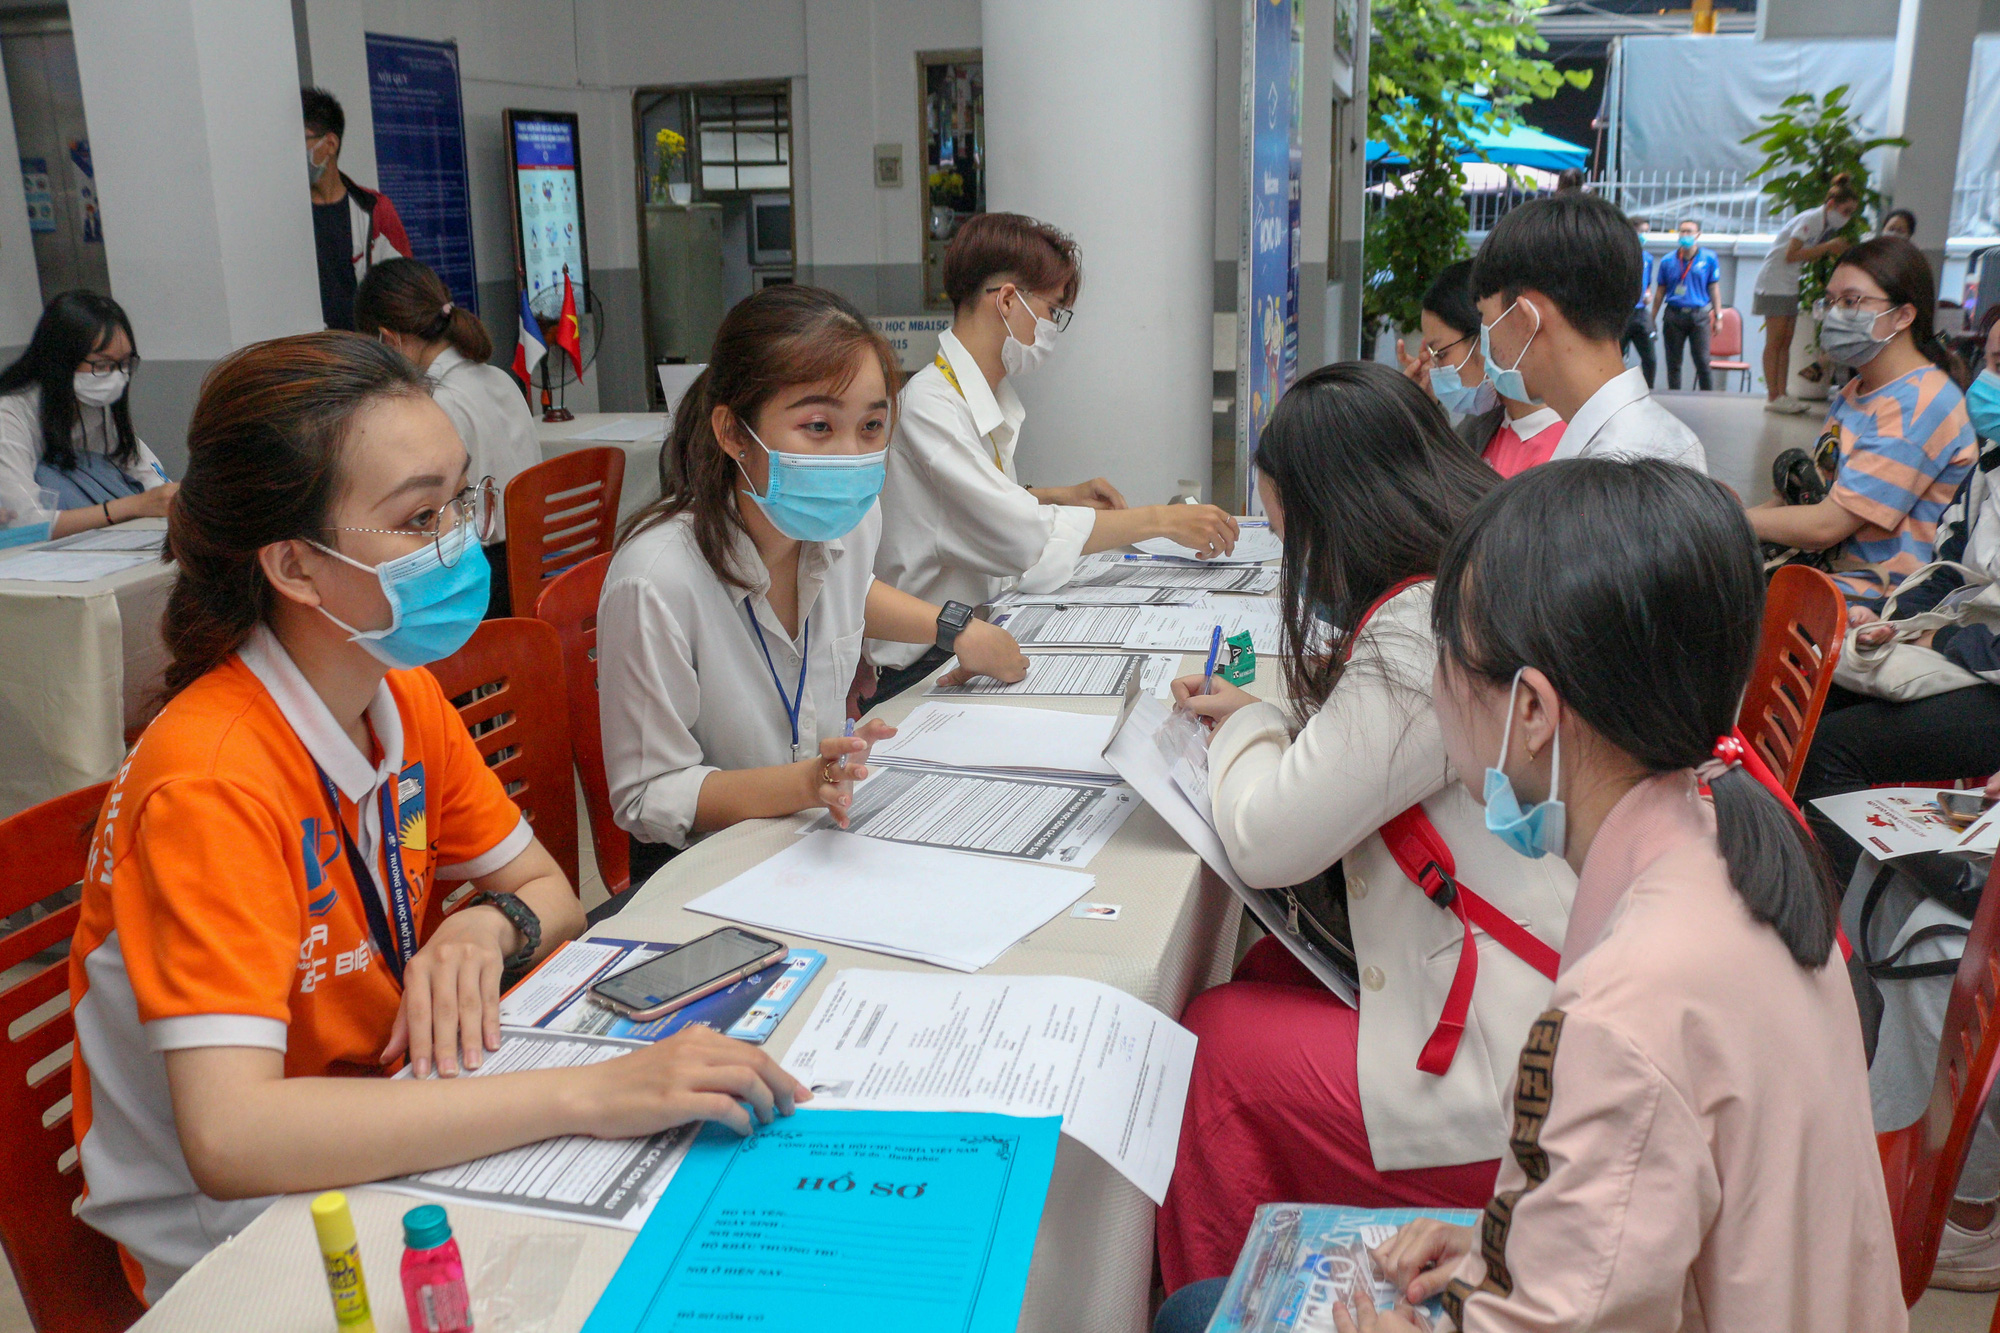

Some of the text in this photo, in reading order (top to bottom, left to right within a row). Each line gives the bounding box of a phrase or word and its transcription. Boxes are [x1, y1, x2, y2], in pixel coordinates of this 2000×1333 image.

[885, 321, 907, 333] HỌC
[908, 320, 949, 331] MBA15C
[892, 339, 908, 350] 015
[390, 852, 402, 888] TRƯỜNG
[394, 888, 404, 904] ĐẠI
[398, 904, 407, 922] HỌC
[400, 922, 412, 938] MỞ
[640, 1149, 661, 1168] CÁC
[621, 1166, 646, 1189] LOẠI
[794, 1170, 928, 1200] HỒ SƠ
[604, 1188, 626, 1210] SAU
